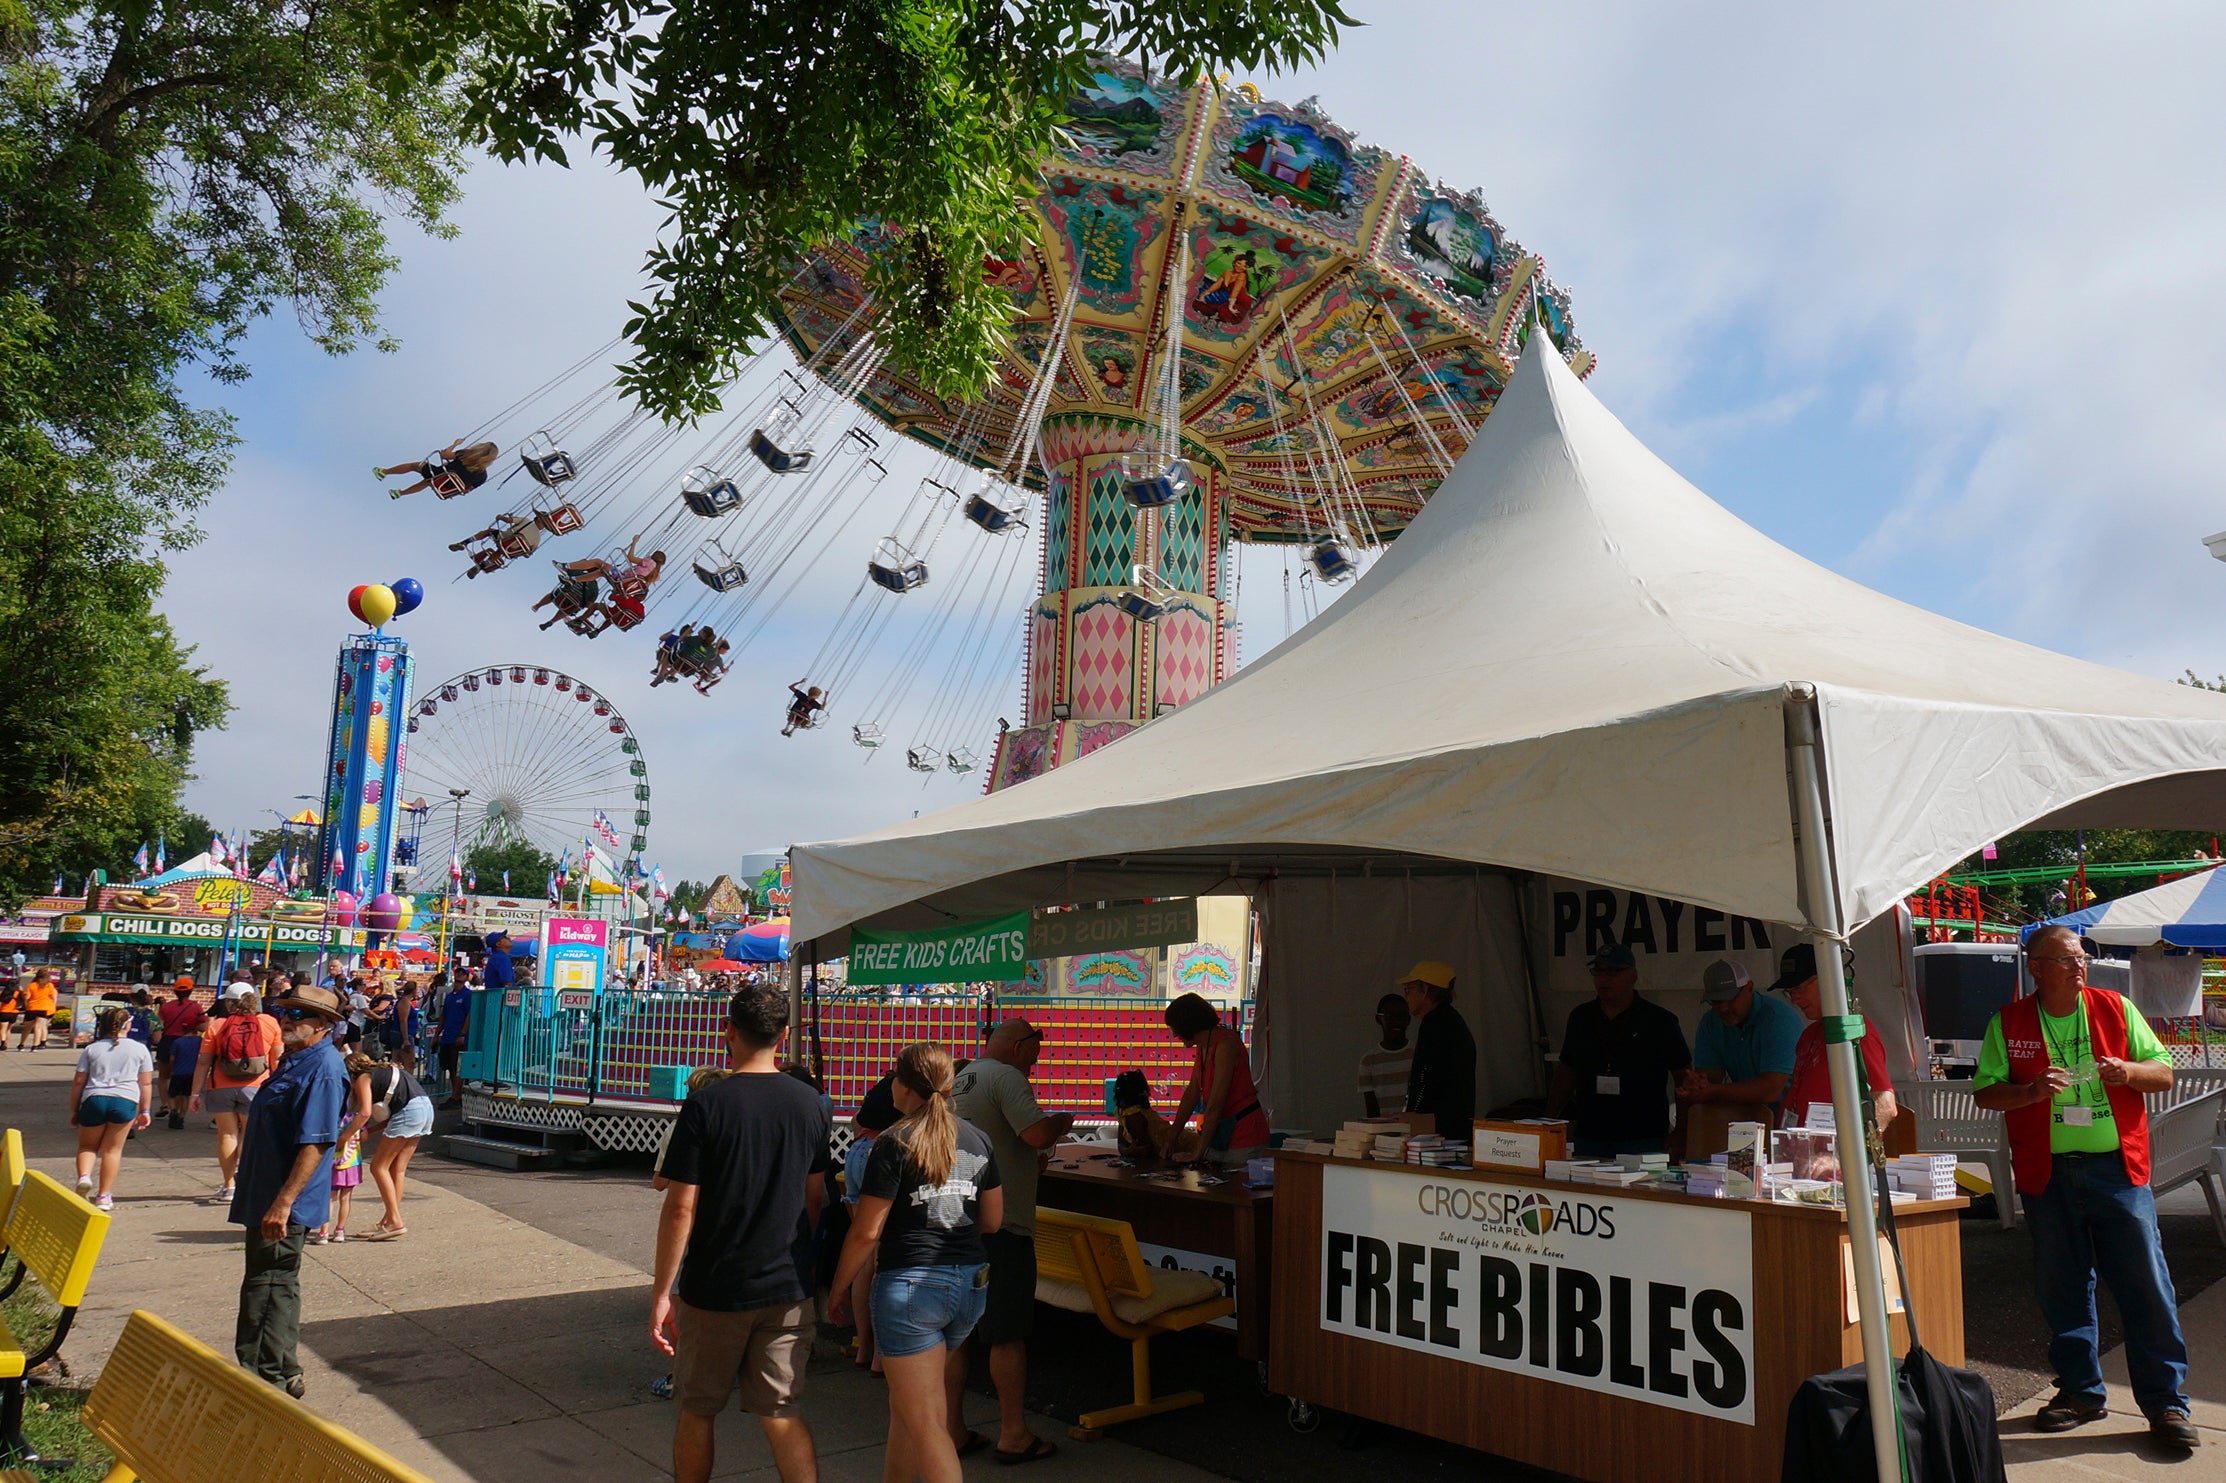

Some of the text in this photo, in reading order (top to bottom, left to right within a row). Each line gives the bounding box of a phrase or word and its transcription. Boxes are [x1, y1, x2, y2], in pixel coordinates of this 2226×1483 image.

[221, 902, 239, 910] DOS
[109, 918, 333, 942] CHILI DOGS HOT DOGS
[1553, 889, 1772, 957] PRAYER
[559, 930, 597, 942] kidway
[854, 930, 1025, 970] FREE KIDS CRAFTS
[564, 994, 591, 1005] EXIT
[2008, 1049, 2036, 1059] TEAM
[1496, 1136, 1517, 1147] Prayer
[1491, 1147, 1521, 1159] Requests
[1481, 1222, 1528, 1238] CHAPEL
[1438, 1231, 1565, 1260] Salt and Light to Make Him Known
[1326, 1230, 1460, 1350] FREE
[1479, 1254, 1748, 1410] BIBLES
